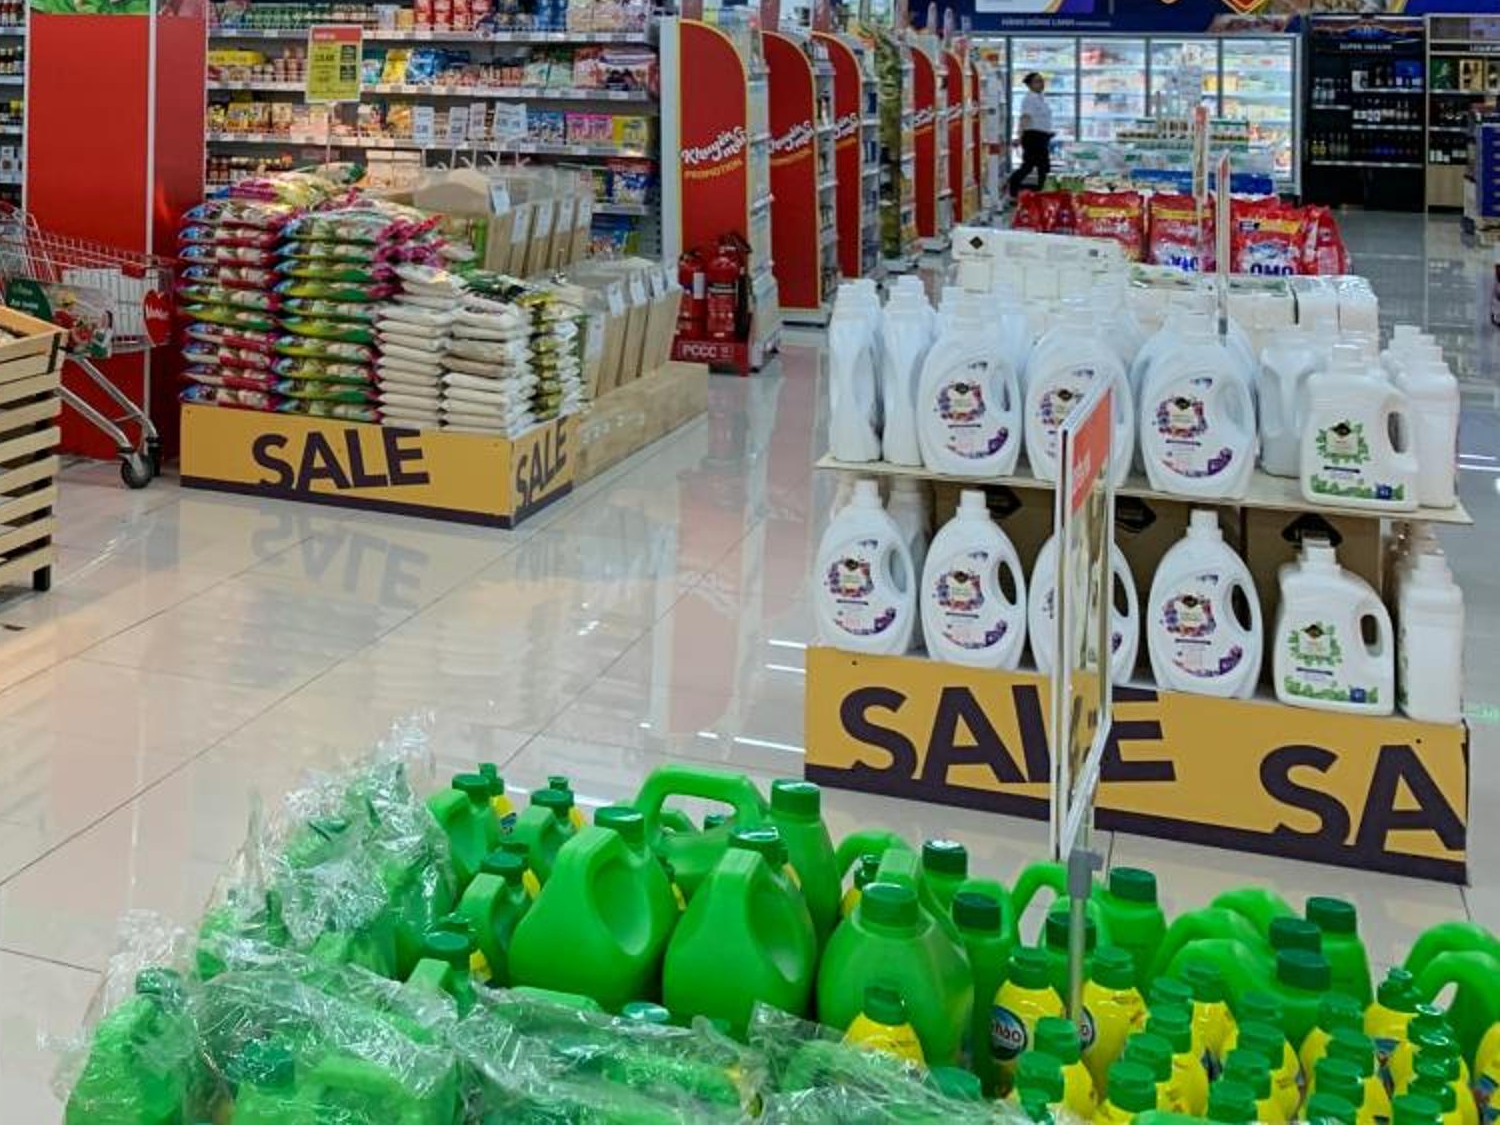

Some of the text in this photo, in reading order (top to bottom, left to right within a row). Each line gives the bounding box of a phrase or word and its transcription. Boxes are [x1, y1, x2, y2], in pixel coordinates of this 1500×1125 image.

[252, 417, 568, 507] SALE SALE
[839, 685, 1467, 853] SALE SA
